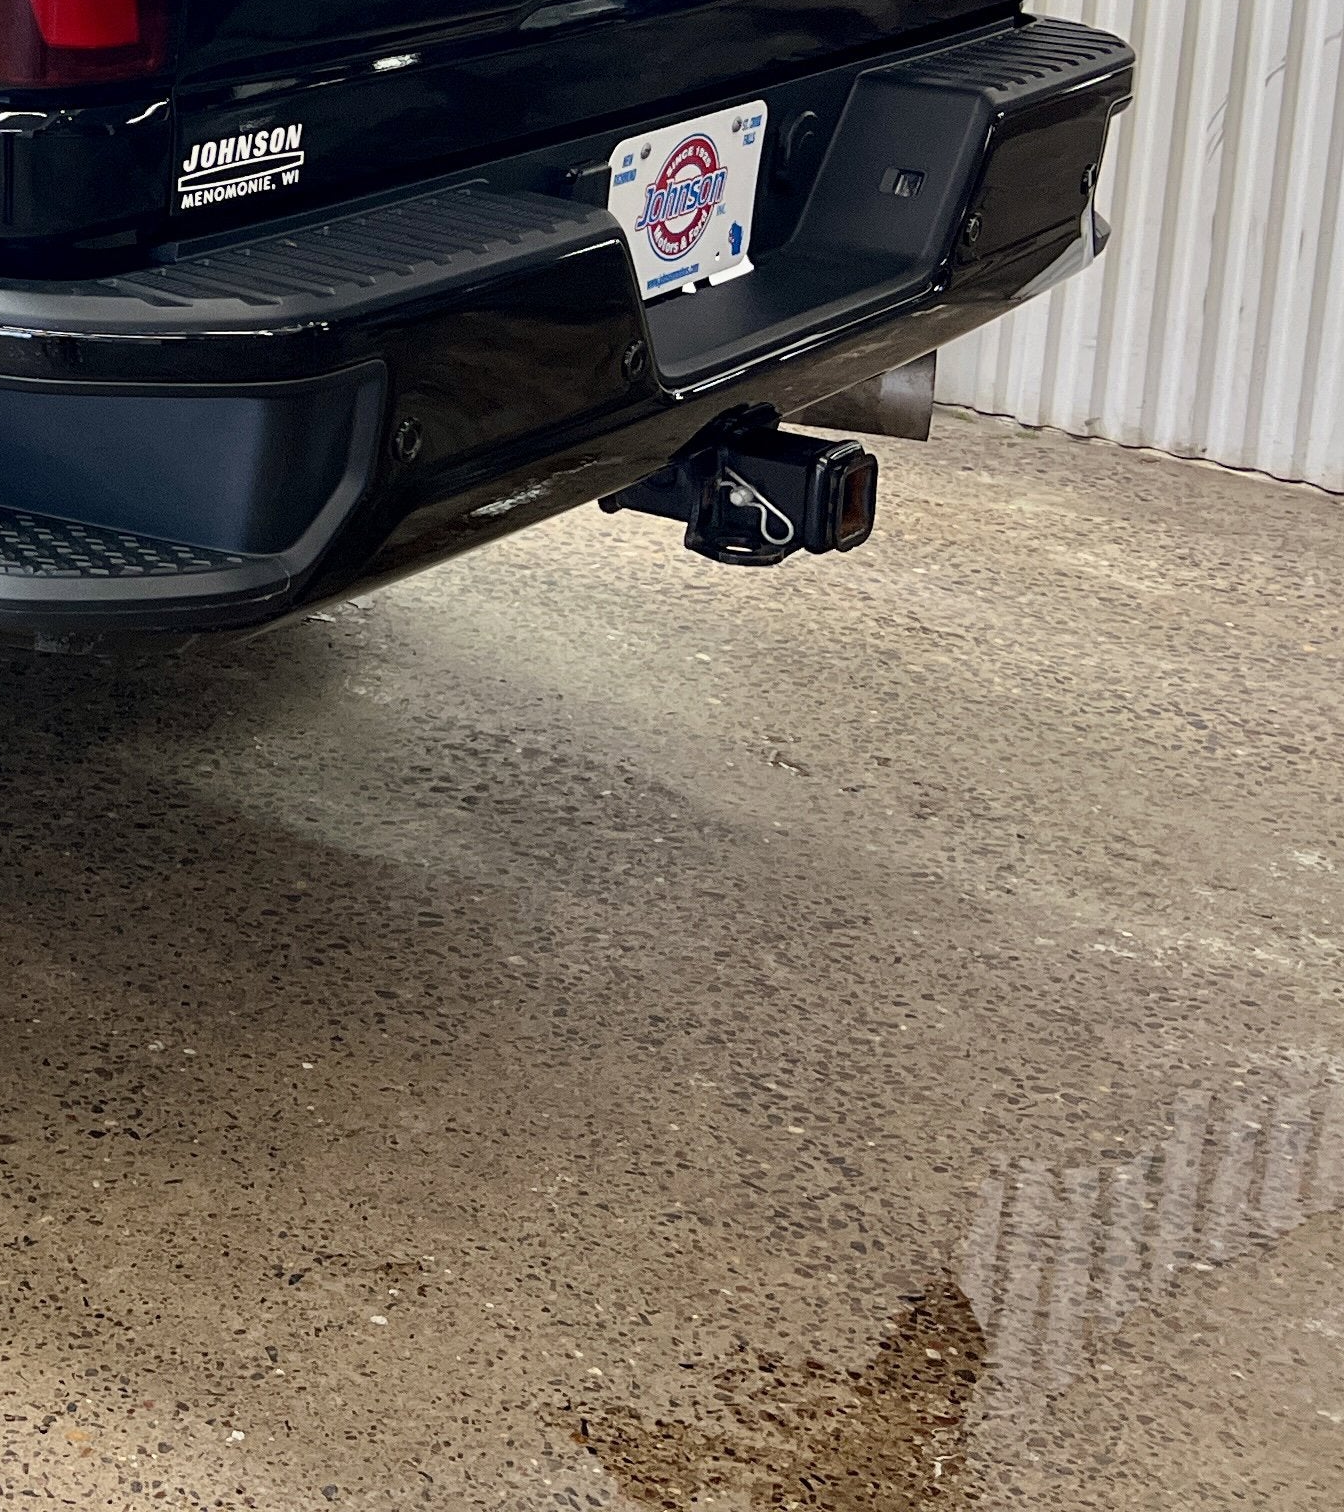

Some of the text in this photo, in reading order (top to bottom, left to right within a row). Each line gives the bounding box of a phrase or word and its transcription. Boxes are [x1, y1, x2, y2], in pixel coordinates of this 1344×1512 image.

[182, 123, 303, 172] JOHNSON
[666, 145, 695, 178] SINCE
[181, 169, 300, 210] MENOMONIE, WI
[635, 167, 728, 231] Johnson
